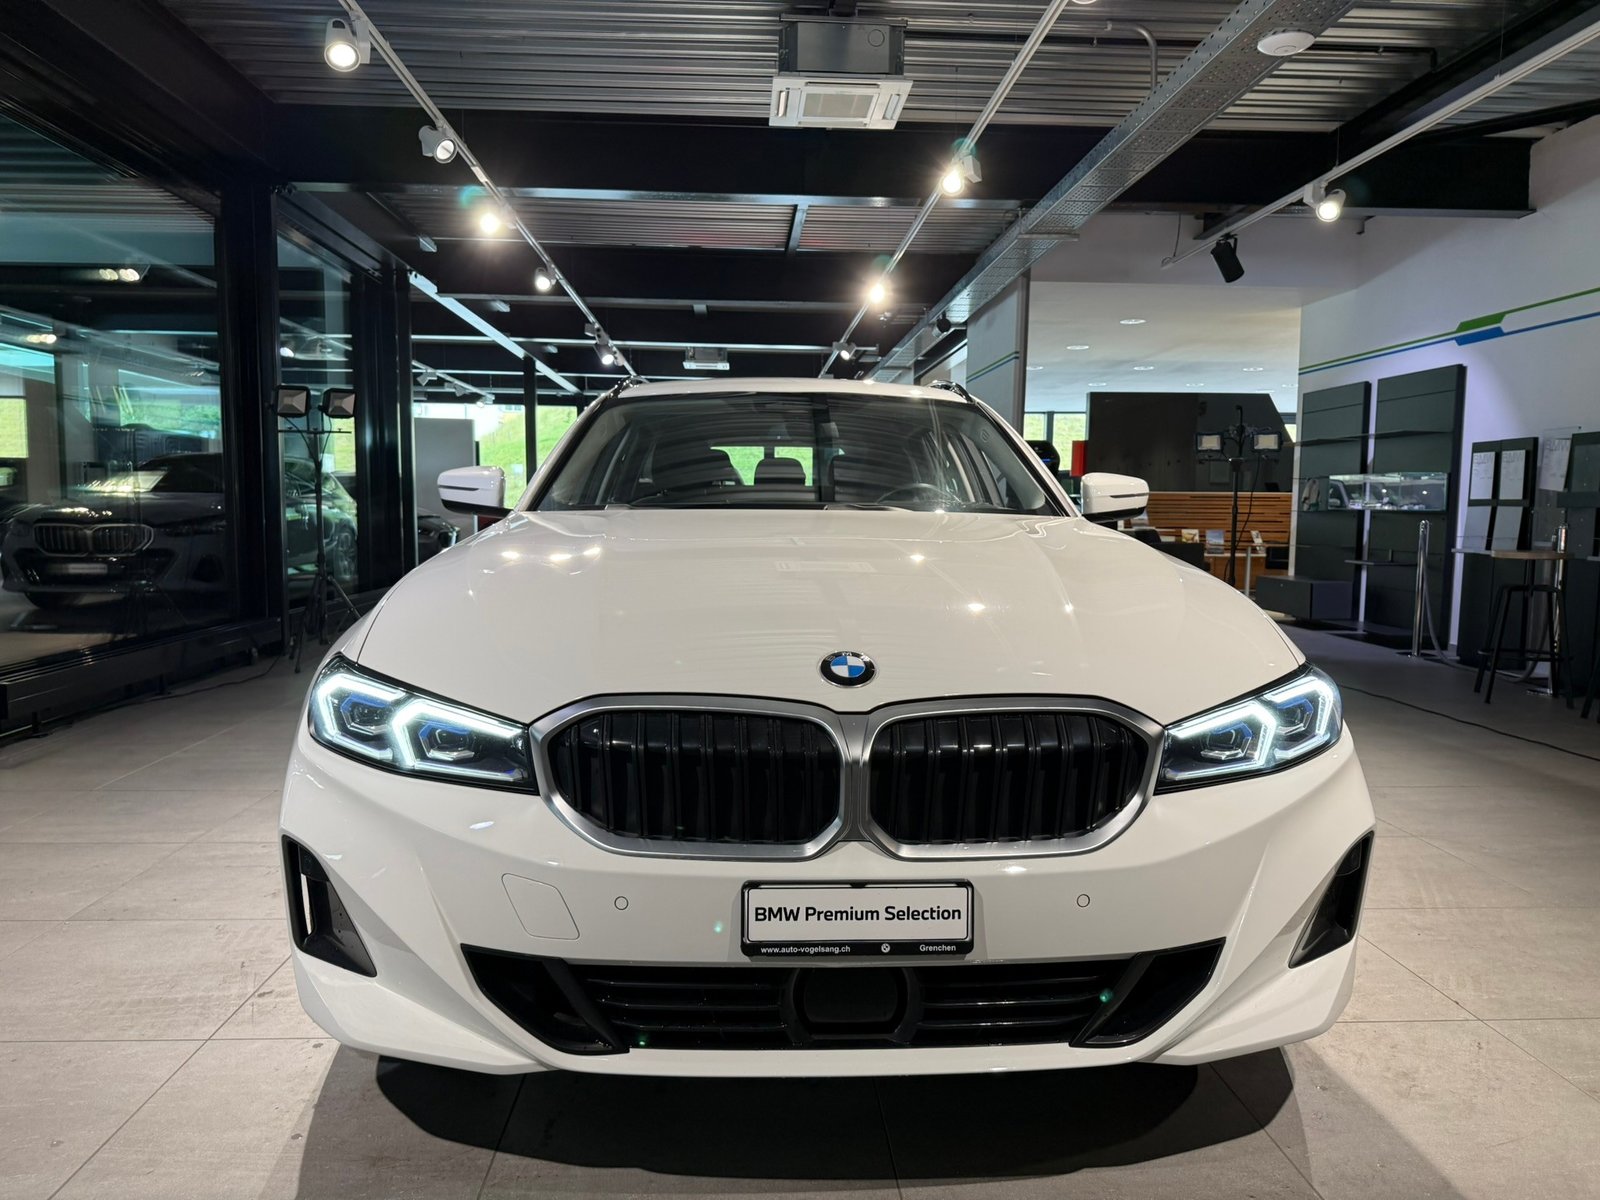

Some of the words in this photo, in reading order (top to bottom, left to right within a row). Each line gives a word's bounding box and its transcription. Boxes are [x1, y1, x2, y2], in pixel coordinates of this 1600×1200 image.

[754, 906, 801, 922] BMW
[805, 905, 880, 921] Premium
[884, 904, 962, 921] Selection
[760, 944, 851, 954] www.auto-vogelsang.ch
[919, 943, 957, 952] Grenchen
